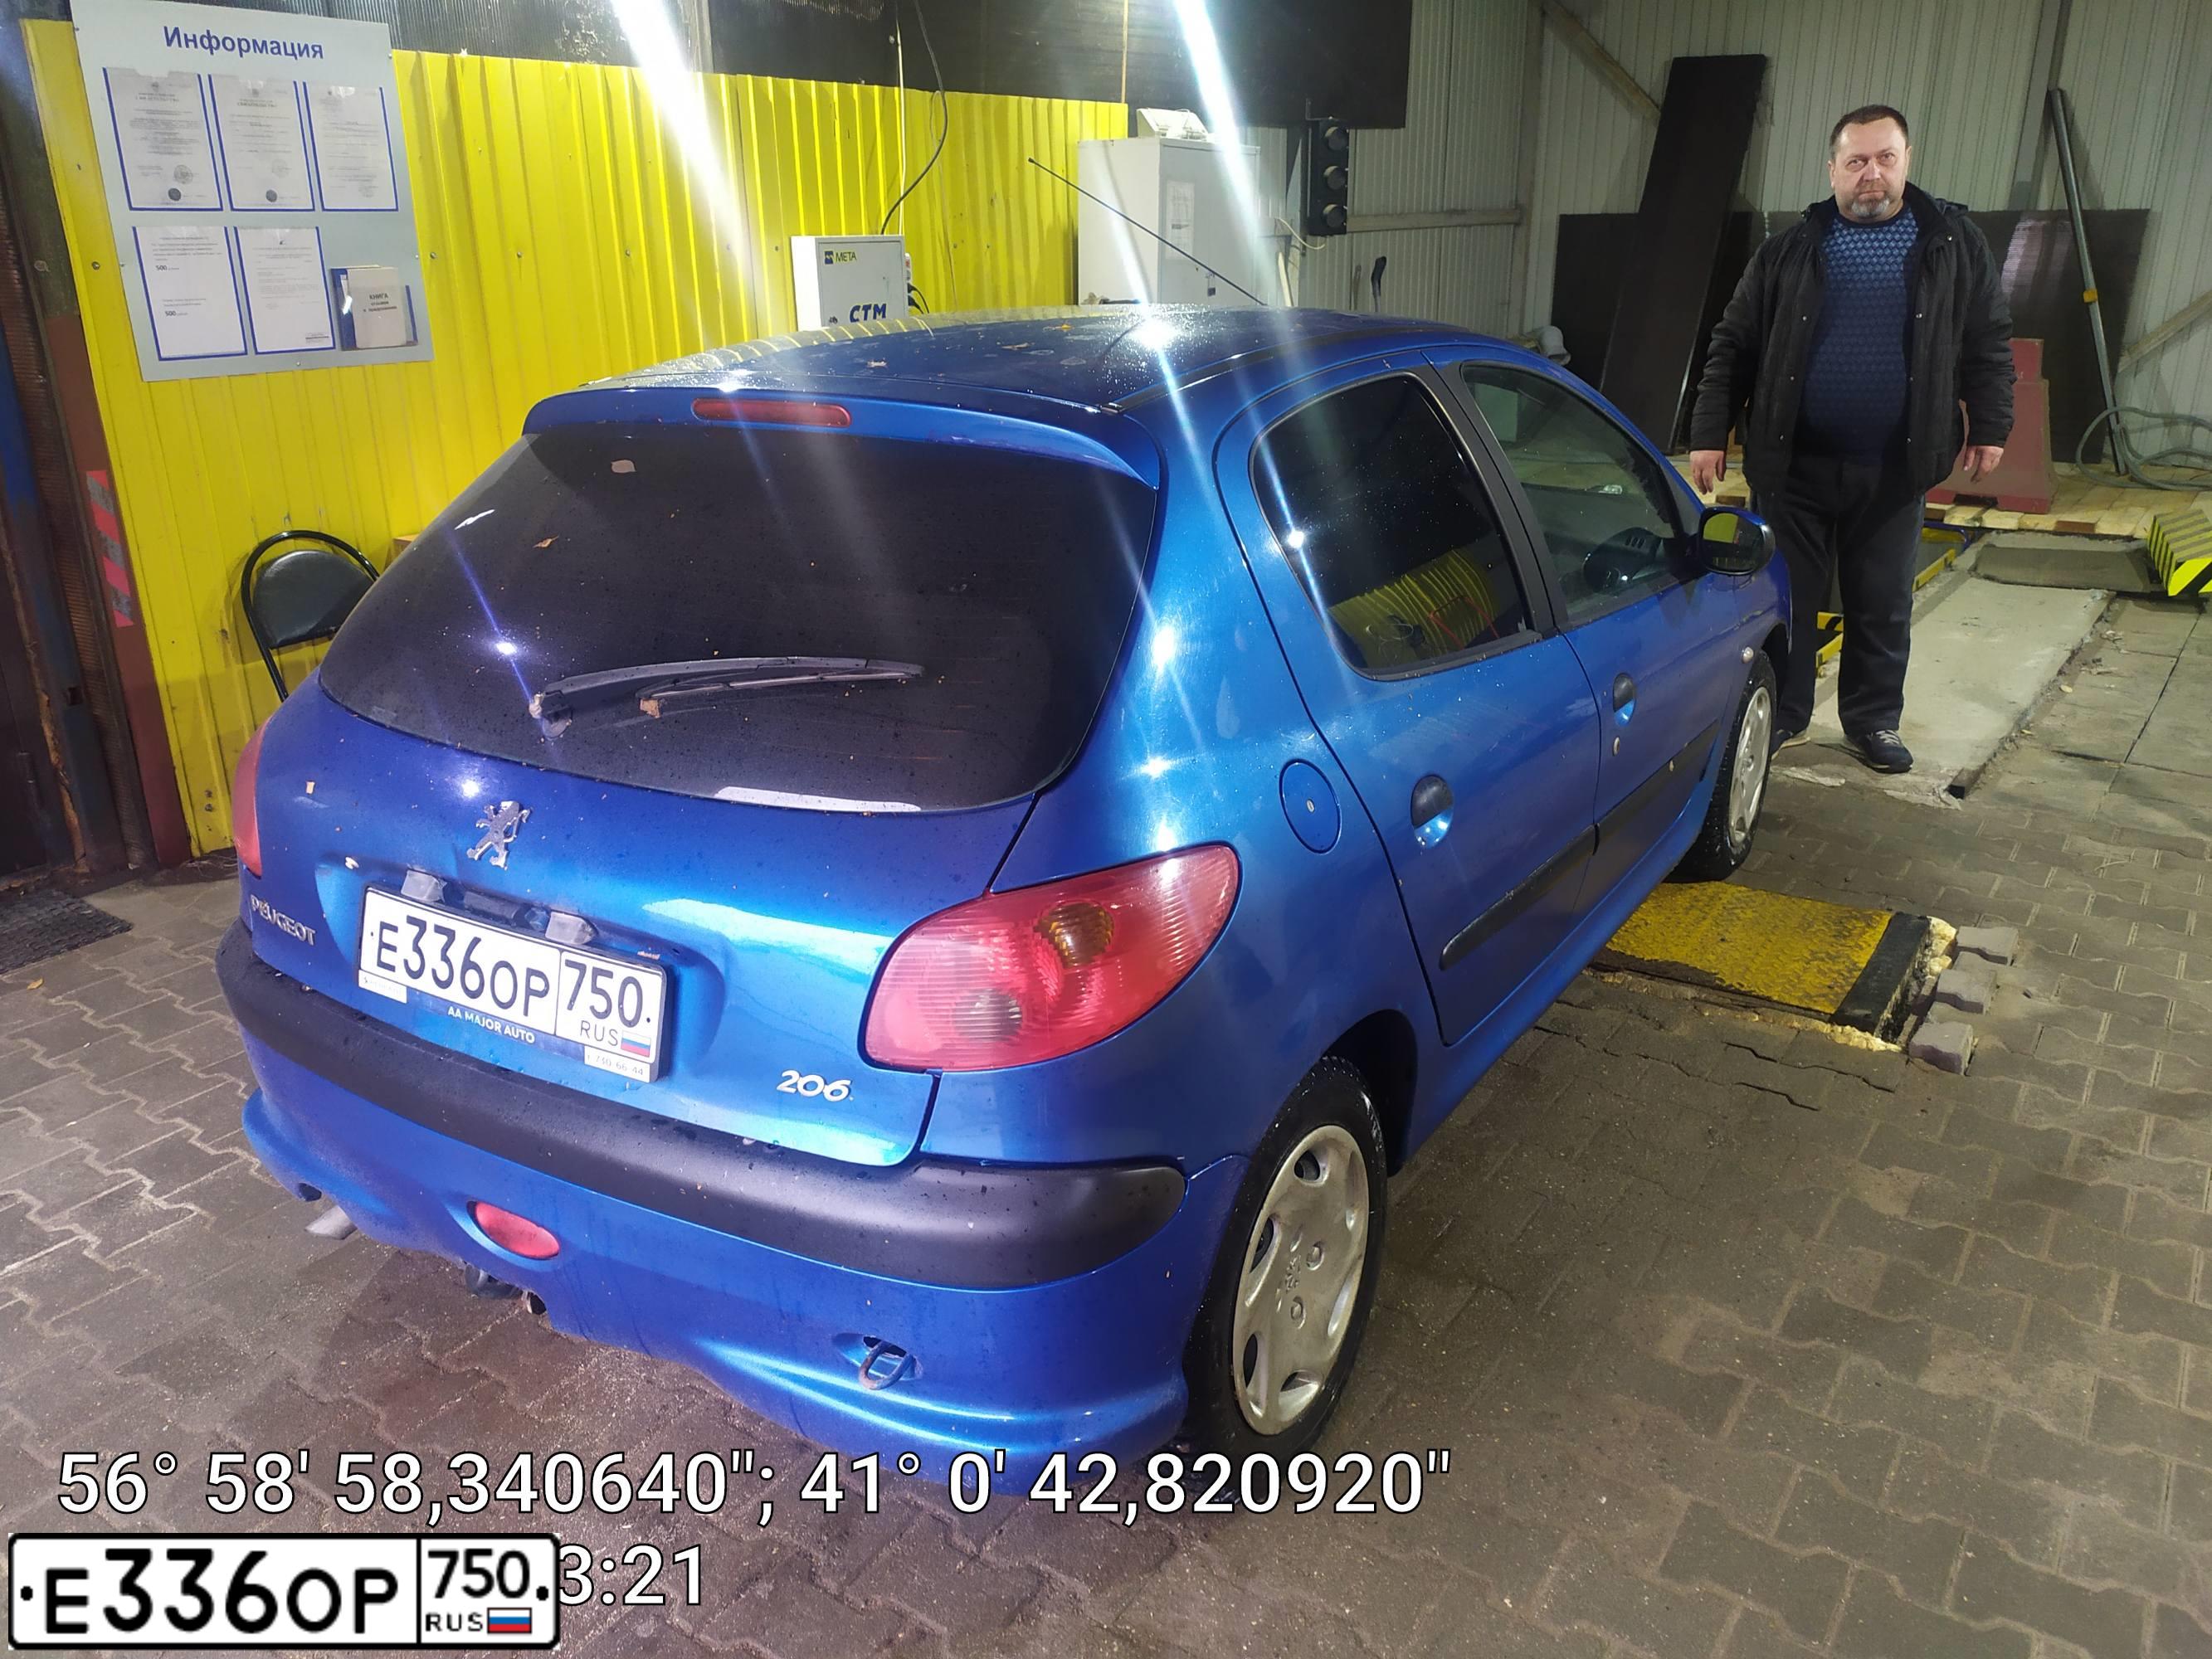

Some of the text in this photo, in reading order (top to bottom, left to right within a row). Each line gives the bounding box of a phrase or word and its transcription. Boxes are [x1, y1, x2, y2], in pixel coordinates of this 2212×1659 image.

[163, 26, 324, 60] Информация
[251, 894, 316, 946] PEUGEOT
[564, 959, 643, 1029] 750
[448, 1006, 535, 1044] AA MAJOR AUTO
[580, 1019, 619, 1047] RUS
[776, 1069, 851, 1102] 206
